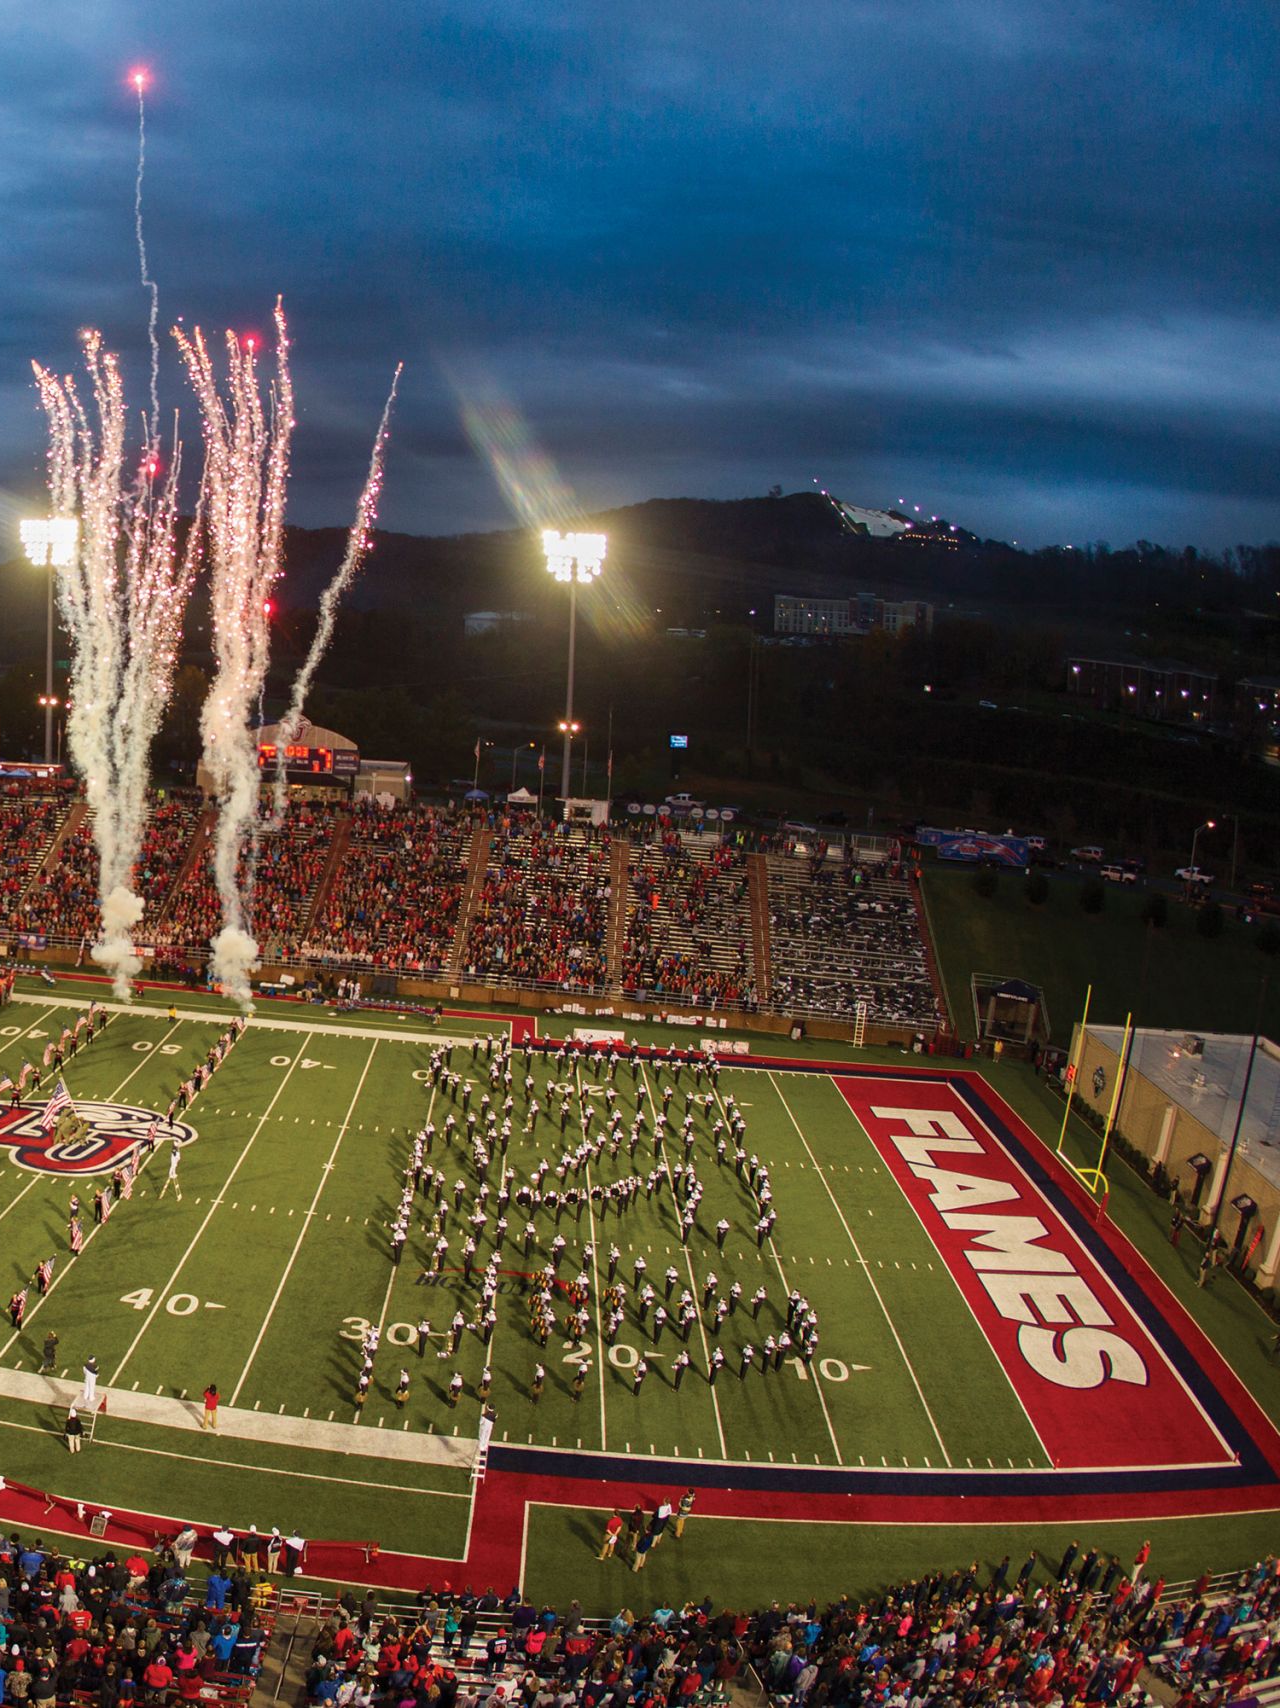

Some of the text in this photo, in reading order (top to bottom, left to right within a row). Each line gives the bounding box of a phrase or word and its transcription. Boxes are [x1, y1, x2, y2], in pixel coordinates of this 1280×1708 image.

[869, 1105, 1151, 1390] FLAMES
[415, 1274, 459, 1290] BIG
[119, 1287, 199, 1316] 40
[338, 1316, 418, 1345] 30
[561, 1340, 639, 1368] 20
[784, 1357, 850, 1382] 10
